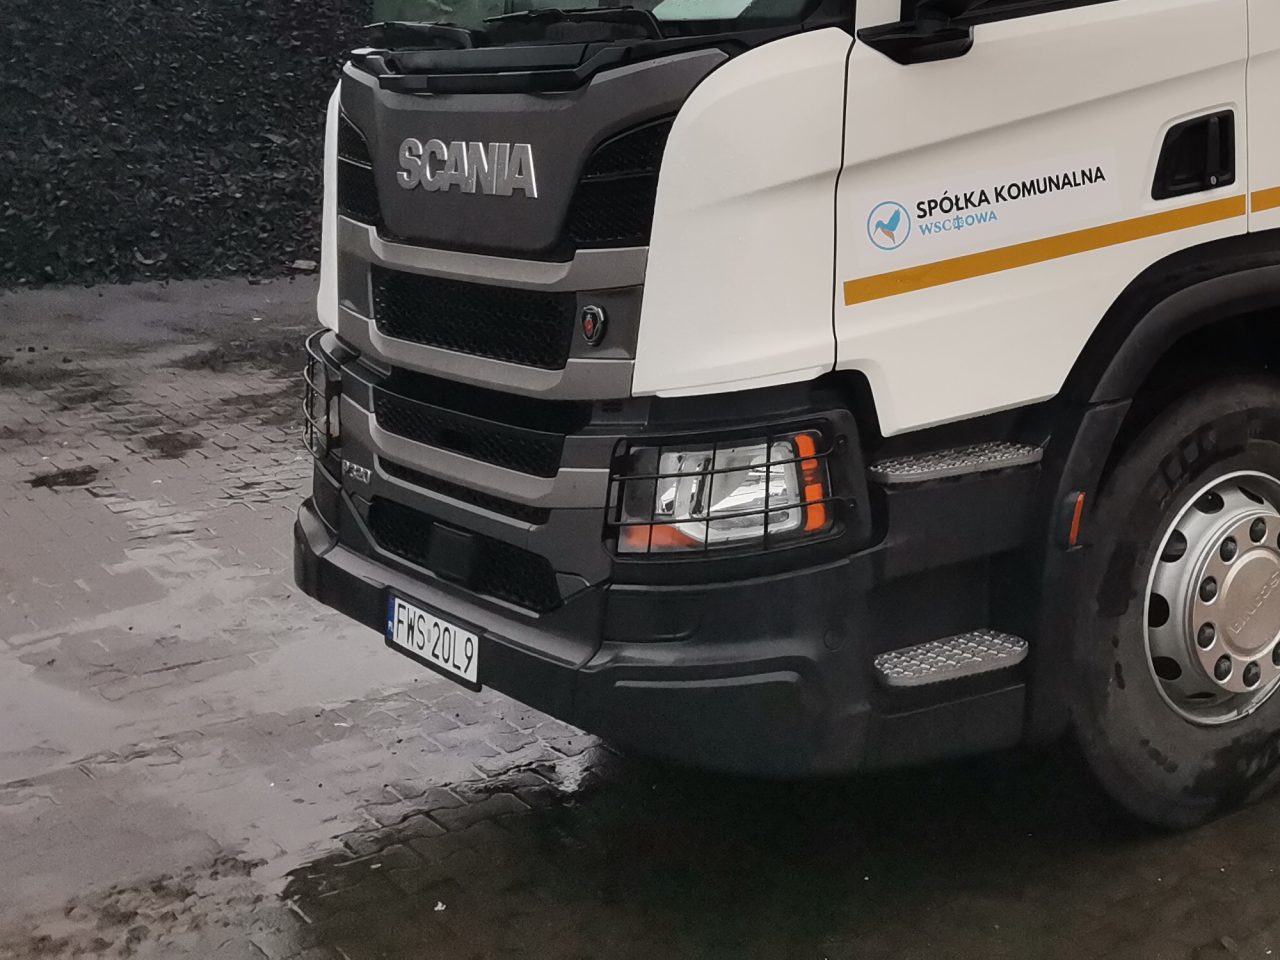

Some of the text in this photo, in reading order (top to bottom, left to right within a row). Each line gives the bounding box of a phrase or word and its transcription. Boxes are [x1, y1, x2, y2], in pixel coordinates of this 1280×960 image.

[397, 138, 538, 198] SCANIA
[916, 166, 1106, 219] SPÓŁKA KOMUNALNA
[396, 603, 474, 674] FWS 20L9
